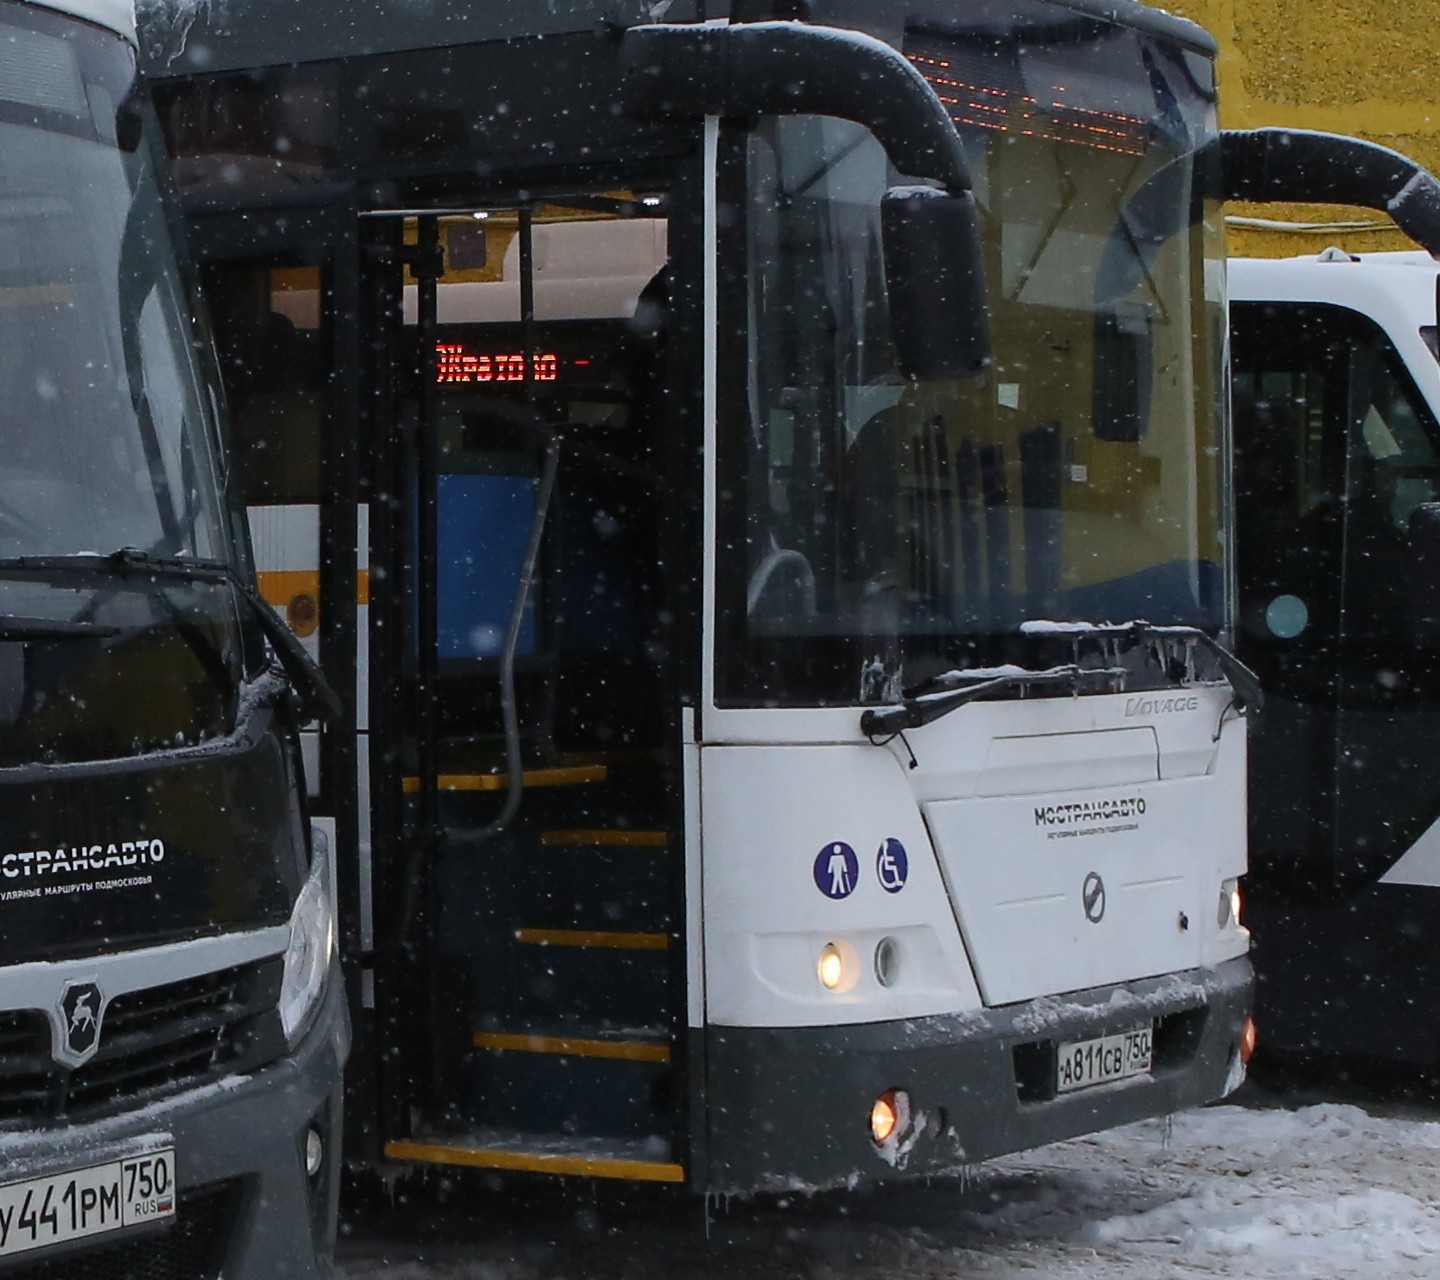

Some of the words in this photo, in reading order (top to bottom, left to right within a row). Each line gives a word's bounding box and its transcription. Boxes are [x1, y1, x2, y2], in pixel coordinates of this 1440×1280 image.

[1034, 797, 1147, 826] МОСТРАНСАВТО
[44, 882, 93, 895] МАРШРУТЫ
[95, 875, 153, 890] ПОДМОСКОВЬЯ
[1063, 1043, 1122, 1085] А811СВ
[1125, 1033, 1148, 1061] 750
[124, 1157, 167, 1202] 750
[134, 1199, 157, 1216] RUS
